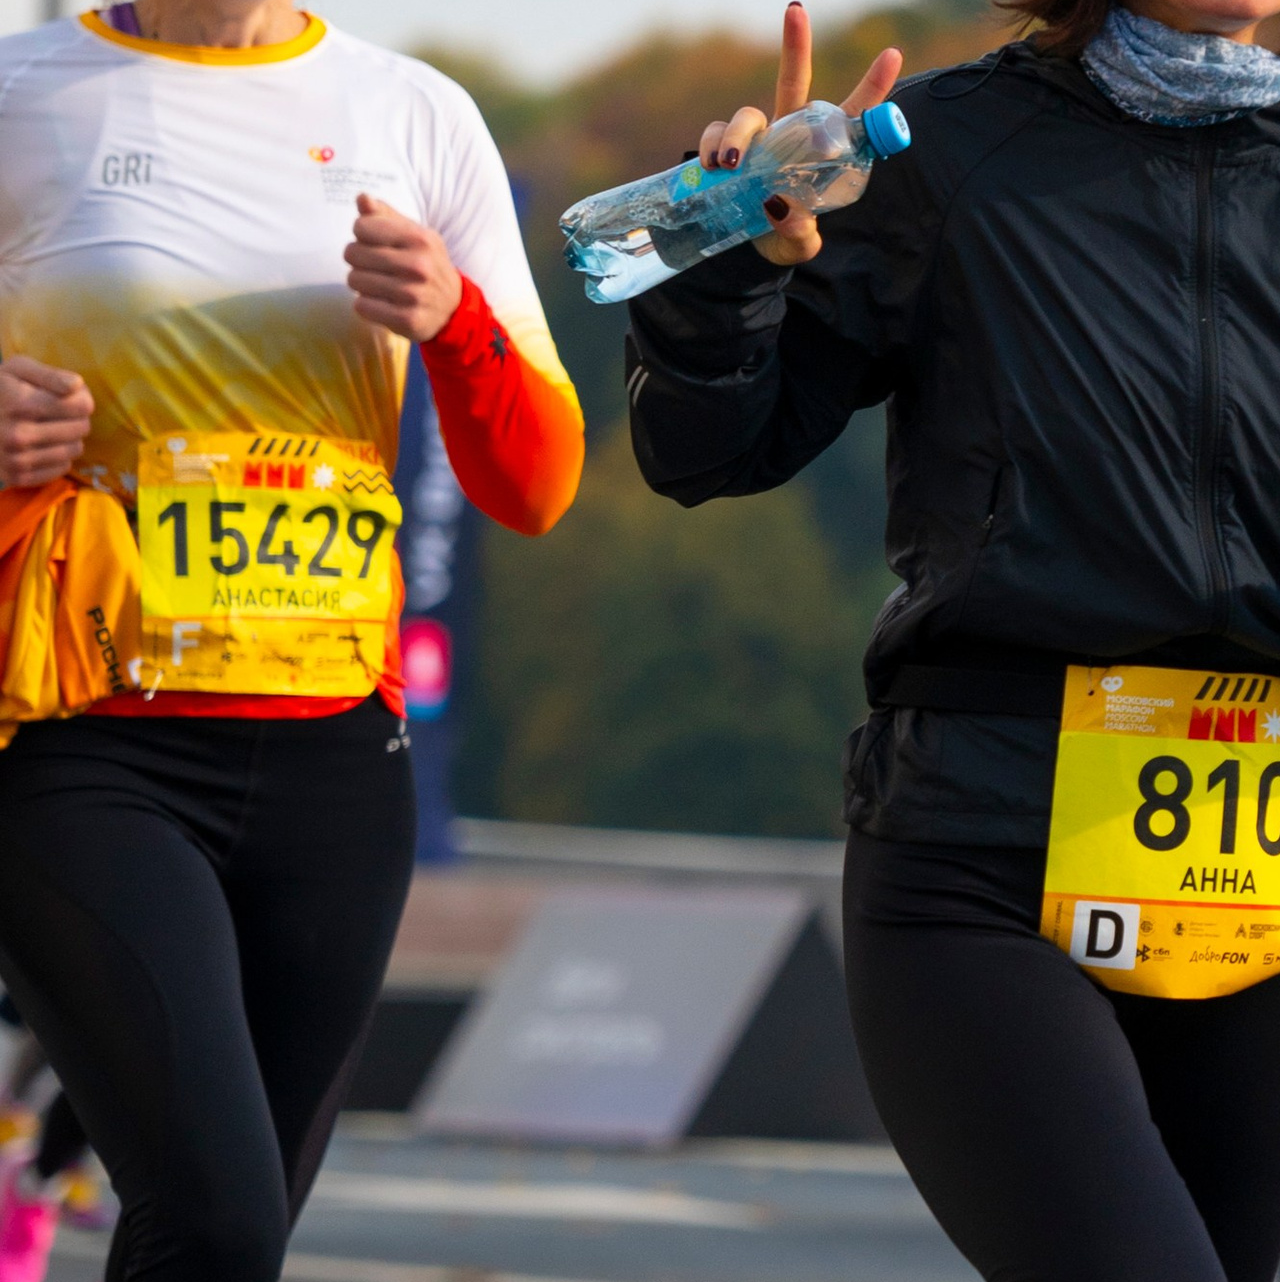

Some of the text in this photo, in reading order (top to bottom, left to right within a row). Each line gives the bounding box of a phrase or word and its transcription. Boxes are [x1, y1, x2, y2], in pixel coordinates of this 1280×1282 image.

[157, 499, 388, 580] 15429
[212, 588, 341, 613] АНАСТАСИЯ
[171, 620, 203, 666] F
[1105, 704, 1155, 715] МАРАФОН
[1106, 694, 1175, 708] МОСКОВСКИЙ
[1103, 722, 1156, 733] MARATHON
[1105, 713, 1149, 724] MOSCOW
[1179, 867, 1257, 895] АННА
[1085, 909, 1125, 959] D
